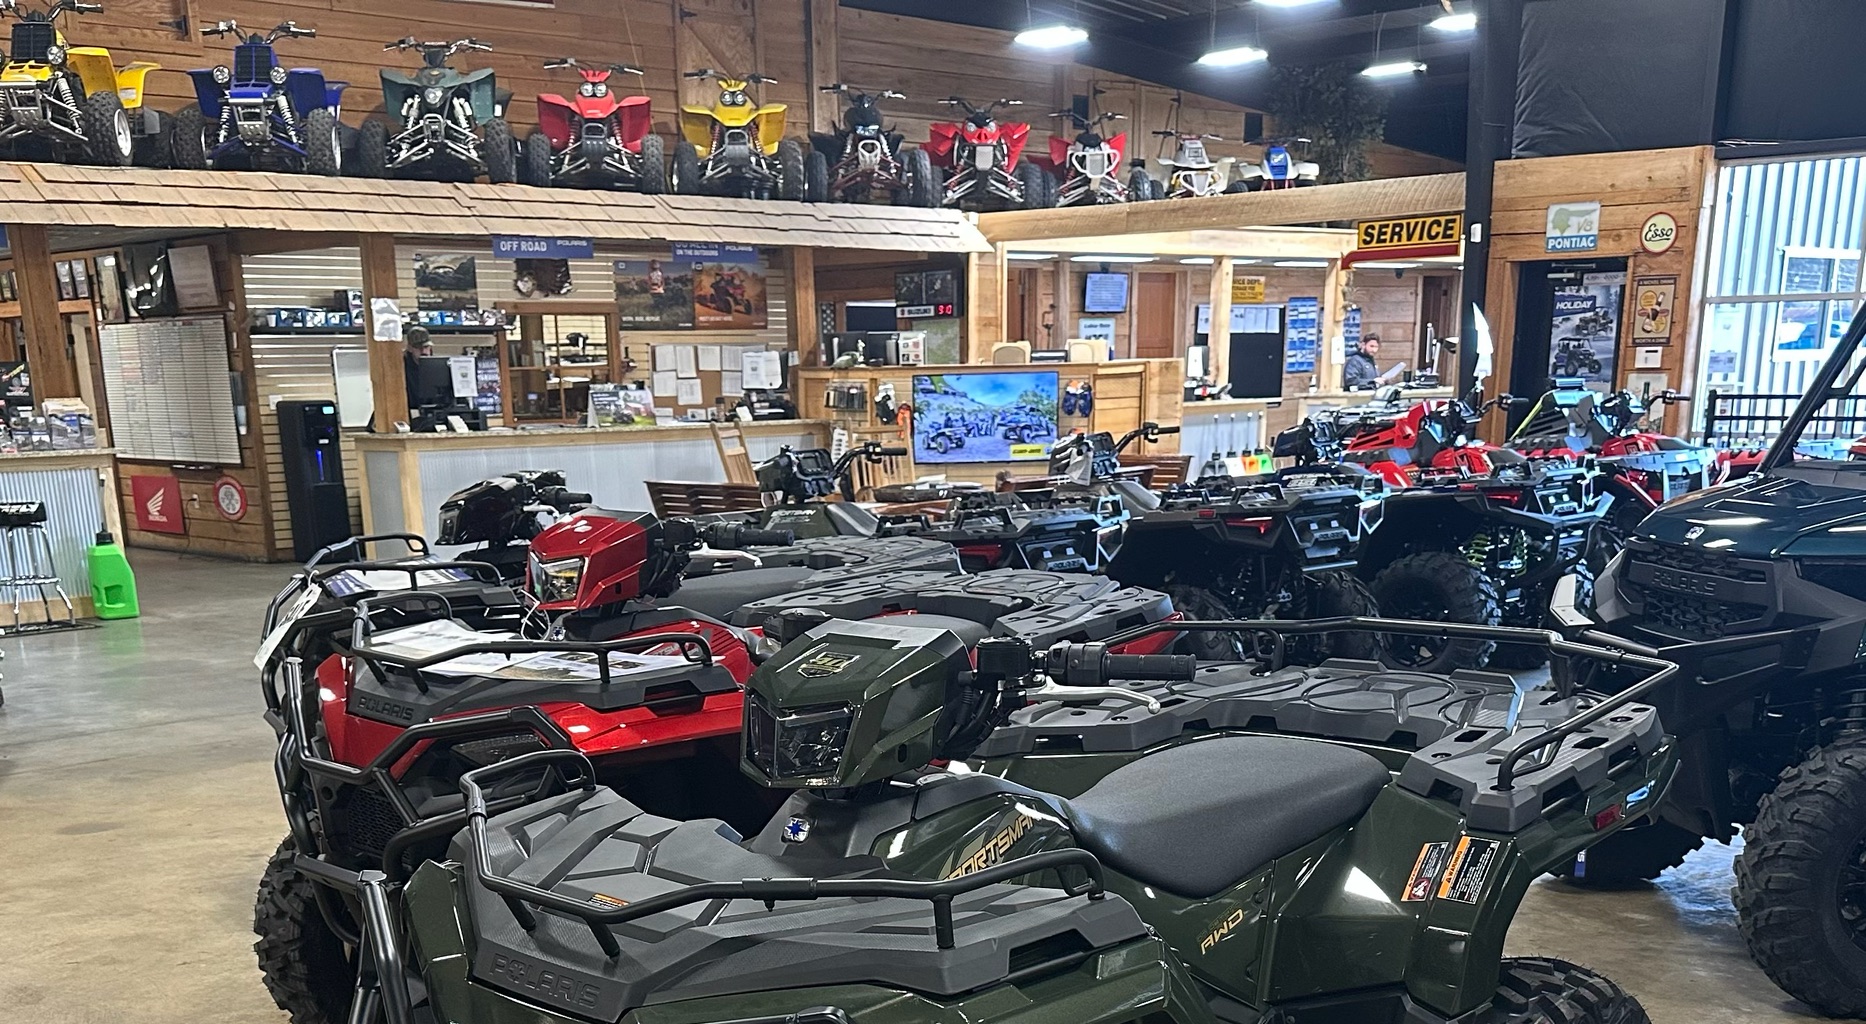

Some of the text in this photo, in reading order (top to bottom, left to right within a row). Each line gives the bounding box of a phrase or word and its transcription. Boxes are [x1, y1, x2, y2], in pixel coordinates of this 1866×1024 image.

[1362, 218, 1457, 245] SERVICE
[1577, 217, 1593, 233] V8
[1645, 223, 1674, 242] Esso
[500, 241, 547, 252] OFF ROAD
[556, 239, 588, 247] POLARIS
[1547, 236, 1596, 249] PONTIAC
[907, 307, 932, 315] SUZUKI
[1555, 300, 1593, 310] HOLIDAY
[1651, 569, 1717, 596] POLARIS
[357, 697, 415, 721] POLARIS
[1449, 850, 1463, 876] WARNING
[1201, 908, 1244, 955] AWD
[489, 952, 601, 1009] POLARIS
